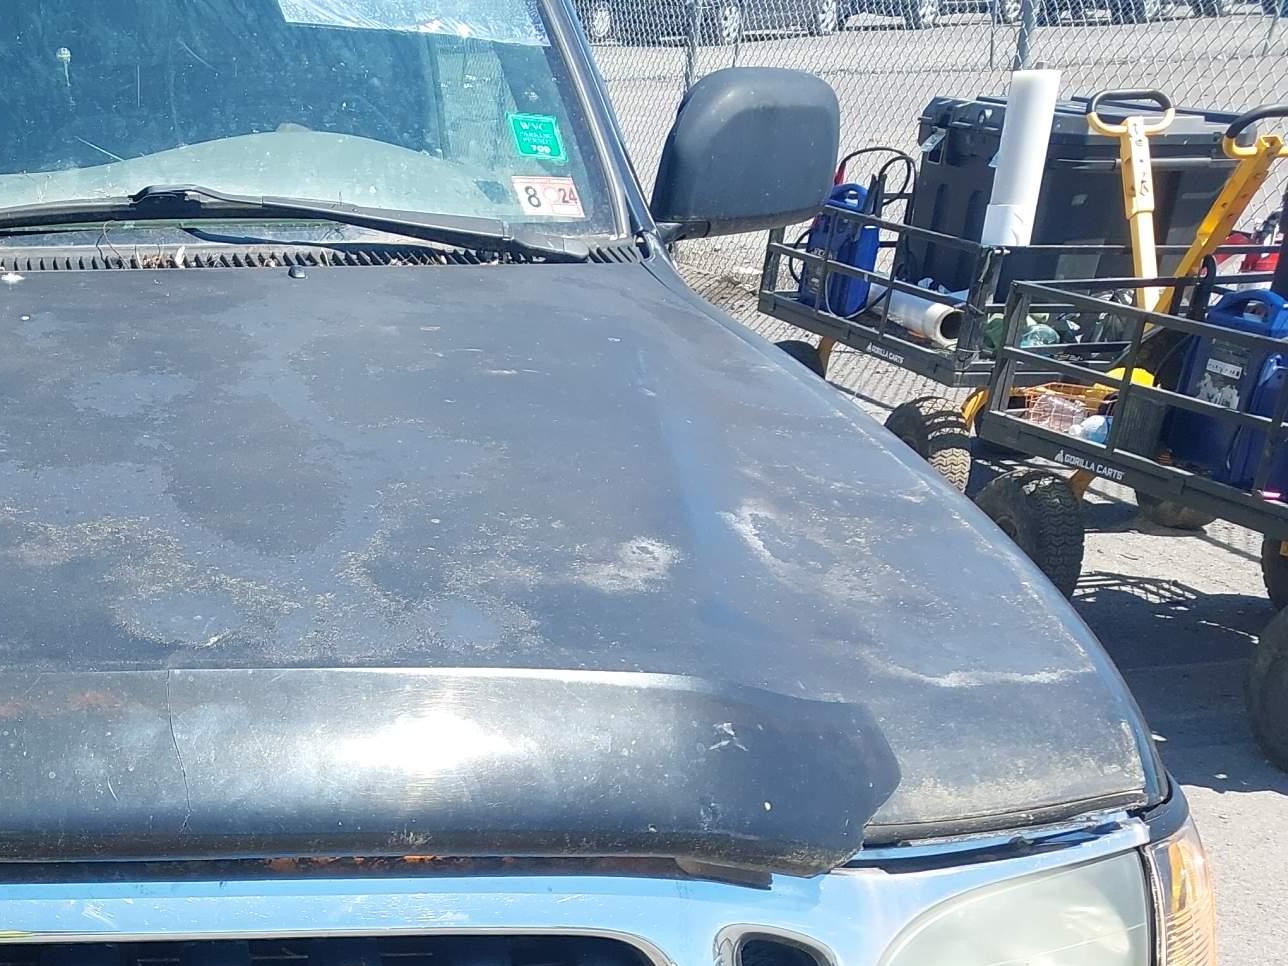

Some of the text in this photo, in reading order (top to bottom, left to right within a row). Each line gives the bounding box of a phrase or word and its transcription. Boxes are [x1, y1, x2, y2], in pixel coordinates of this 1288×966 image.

[524, 185, 542, 208] 8
[1064, 453, 1124, 481] GORILLA CARTS
